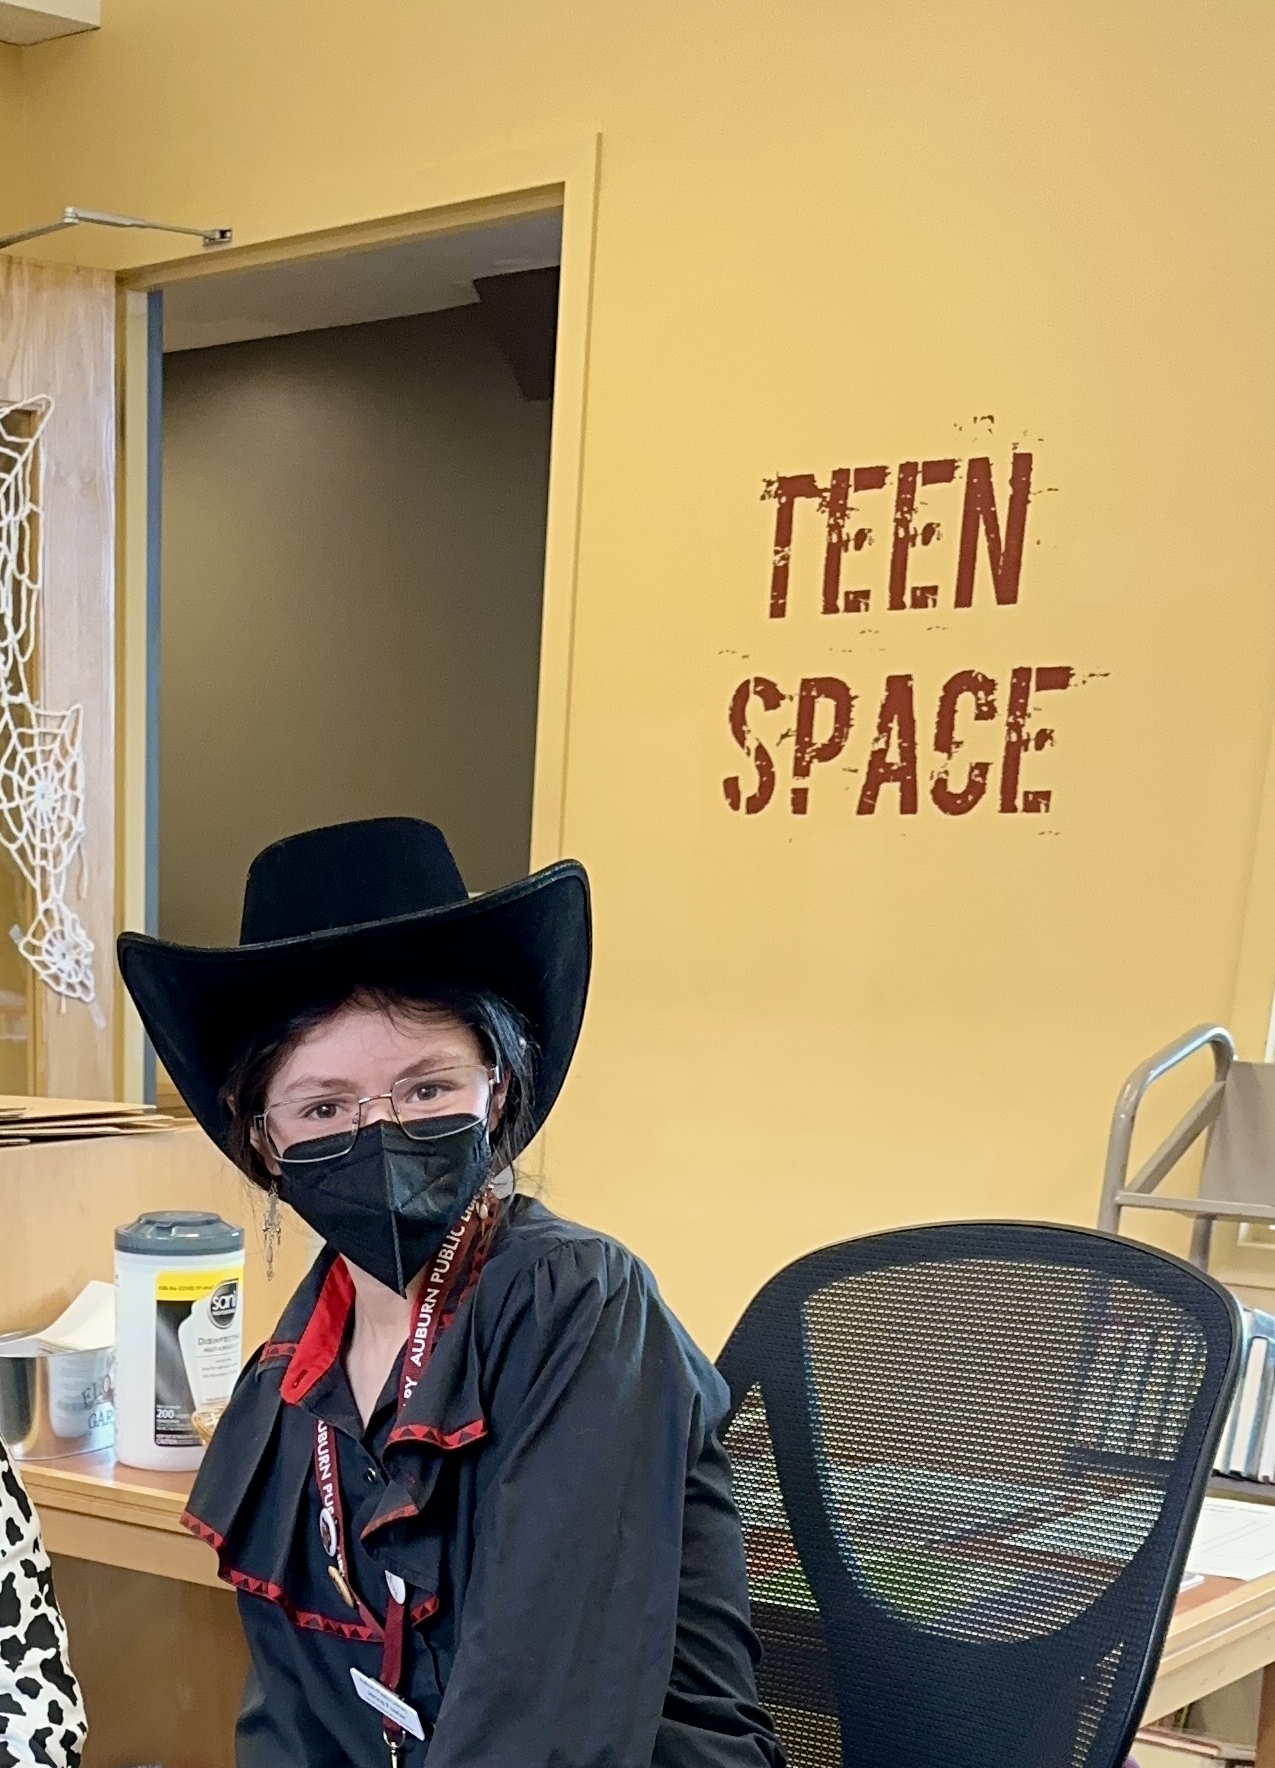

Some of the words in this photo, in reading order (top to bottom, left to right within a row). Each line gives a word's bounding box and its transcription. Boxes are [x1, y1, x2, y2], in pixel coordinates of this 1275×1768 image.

[760, 451, 1034, 620] TEEN
[723, 666, 1076, 817] SPACE
[410, 1288, 441, 1368] AUBURN
[430, 1225, 466, 1284] PUBLIC
[156, 1408, 175, 1419] 200
[317, 1418, 332, 1481] UBURN
